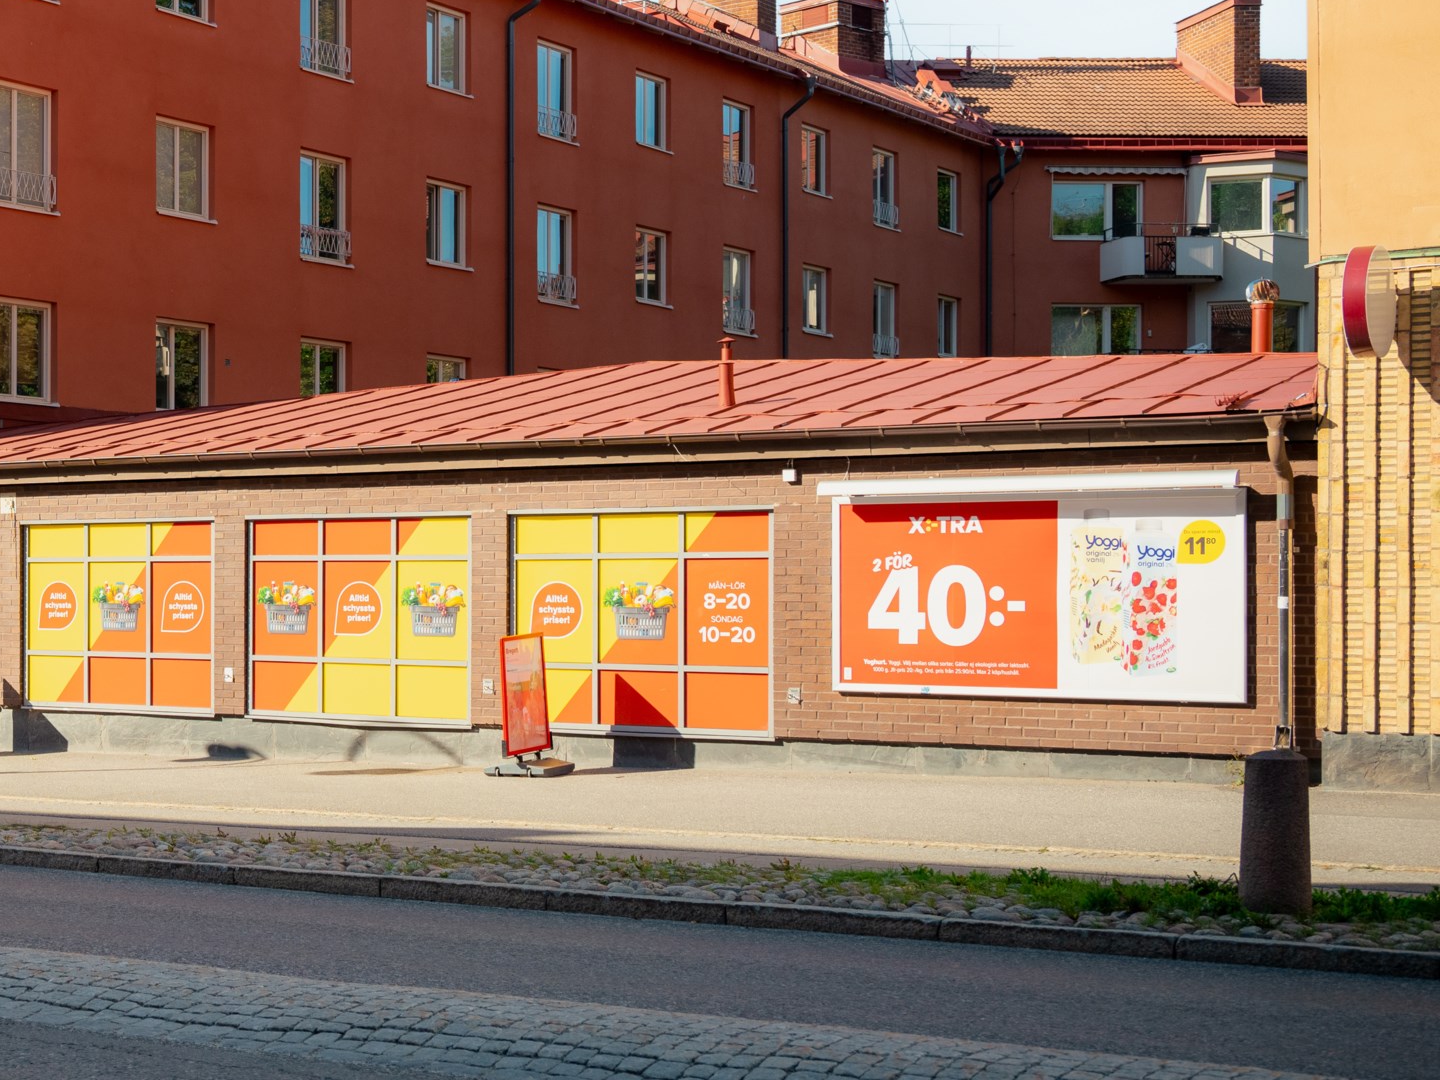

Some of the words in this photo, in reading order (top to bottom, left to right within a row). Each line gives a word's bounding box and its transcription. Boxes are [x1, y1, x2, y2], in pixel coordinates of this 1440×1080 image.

[872, 558, 882, 572] 2
[885, 551, 913, 571] FÖR
[1086, 556, 1105, 564] vanilj
[174, 593, 192, 601] Alltid
[349, 594, 370, 602] Alltid
[545, 595, 568, 603] Alltid
[704, 593, 751, 610] 8-20
[45, 602, 71, 610] schyssta
[168, 602, 198, 611] schyssta
[343, 604, 375, 613] schyssta
[868, 564, 1026, 646] 40:-
[48, 610, 68, 618] priser!
[538, 605, 575, 615] schyssta
[172, 611, 194, 620] priser!
[347, 614, 371, 623] priser!
[711, 614, 743, 623] SÖNDAG
[544, 616, 570, 625] priser!
[699, 626, 756, 643] 10-20
[864, 658, 887, 666] Yoghurt.
